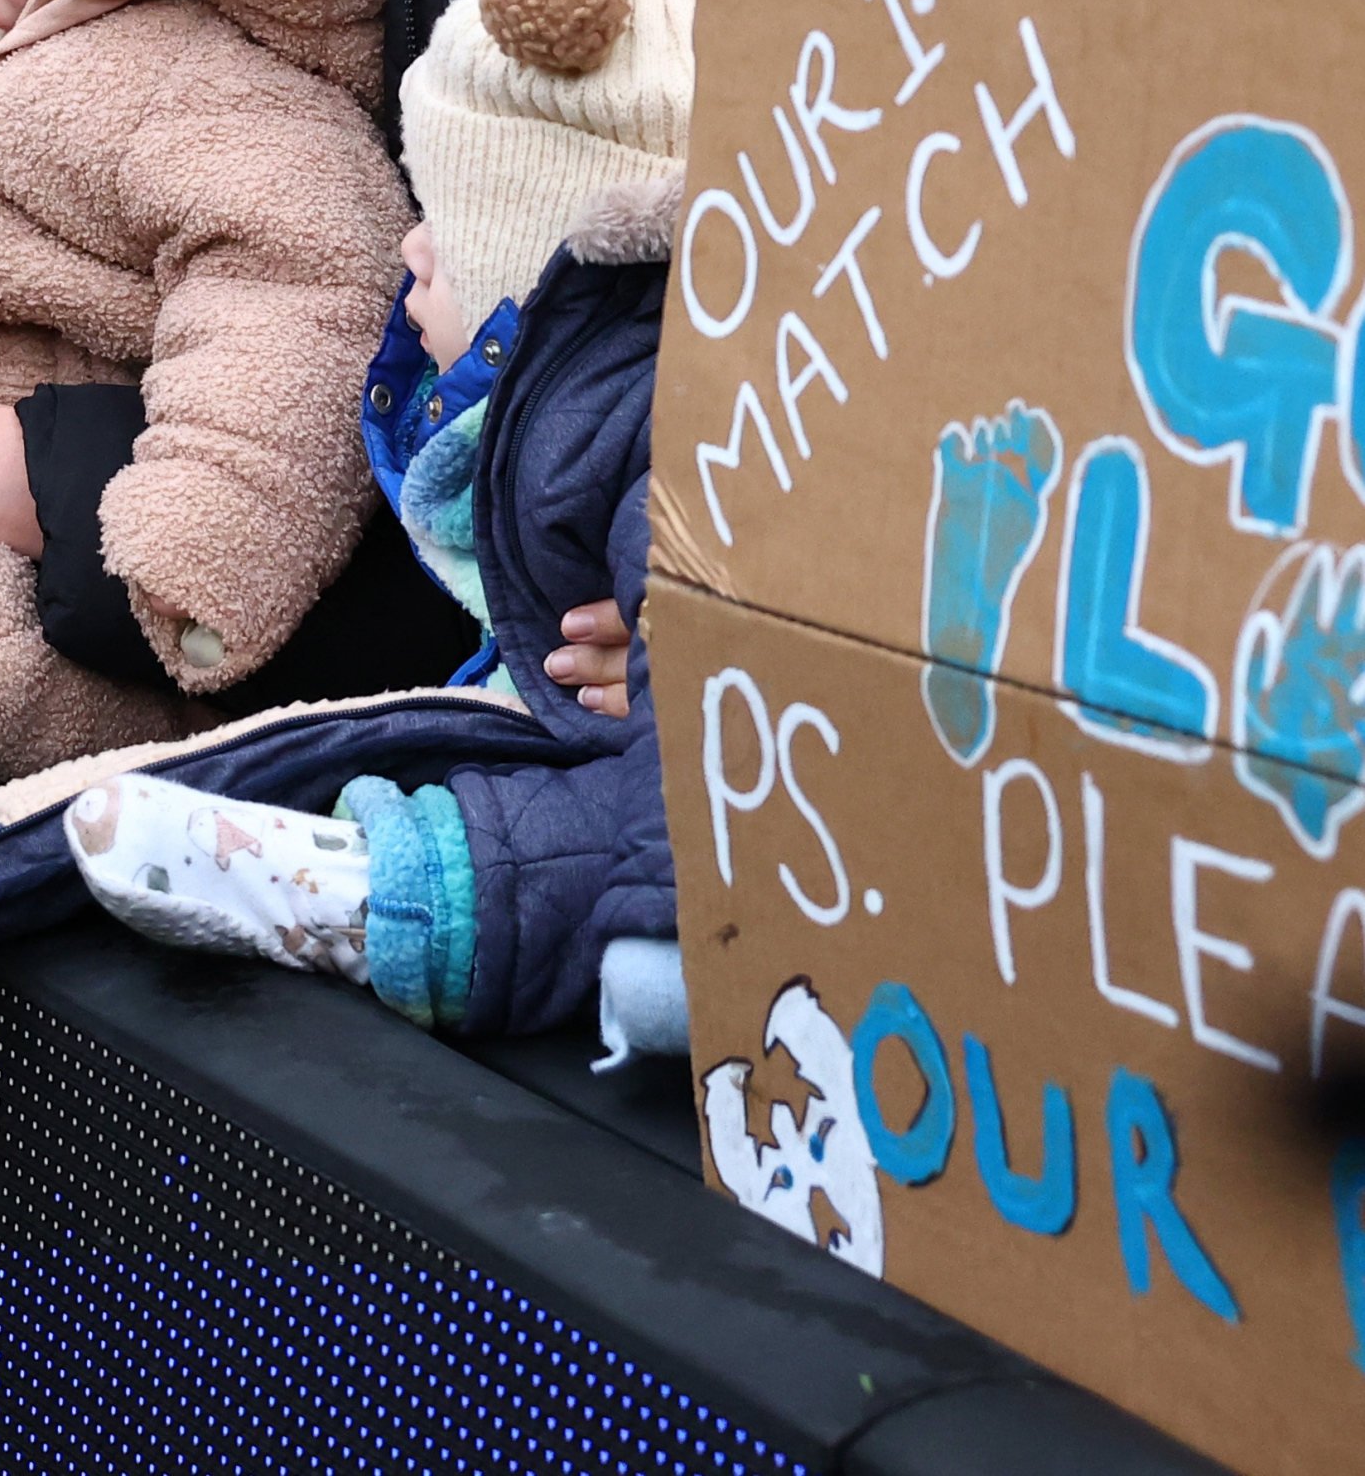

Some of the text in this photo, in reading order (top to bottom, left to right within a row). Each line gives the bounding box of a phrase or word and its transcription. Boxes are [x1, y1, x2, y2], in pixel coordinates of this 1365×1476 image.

[680, 30, 883, 338] OUR
[696, 17, 1076, 547] MATCH
[702, 667, 884, 926] PS.
